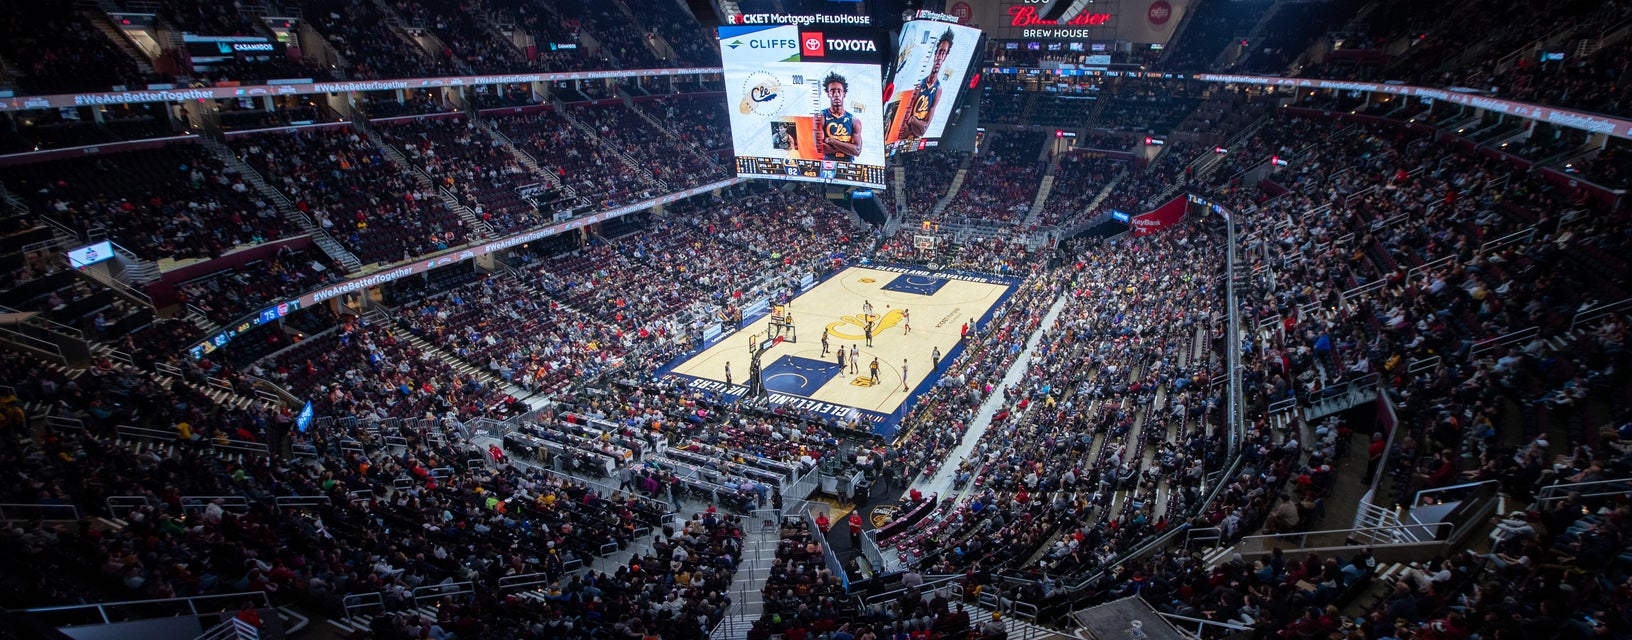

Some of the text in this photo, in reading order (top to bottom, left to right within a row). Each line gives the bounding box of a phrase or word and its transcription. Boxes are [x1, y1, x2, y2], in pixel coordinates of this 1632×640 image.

[728, 13, 769, 25] ROCKET
[770, 13, 815, 26] Mortgage
[1023, 29, 1089, 38] BREW HOUSE
[749, 39, 796, 49] CLIFFS
[827, 39, 876, 51] TOYOTA
[475, 75, 540, 84] #WeAreBetterTogether
[792, 75, 804, 85] 2020
[1205, 74, 1269, 84] #WeAreBetterTogether
[314, 80, 408, 92] #WeAreBetterTogether
[74, 89, 214, 106] #WeAreBetterTogether
[827, 122, 851, 142] Cle
[823, 170, 833, 178] 75
[1132, 218, 1160, 226] KeyBank
[485, 228, 556, 252] #WeAreBetterTogether
[876, 265, 988, 283] CLEVELAND CAVALIERS
[313, 266, 413, 302] #WeAreBetterTogether
[214, 334, 227, 347] 82
[264, 309, 275, 321] 75
